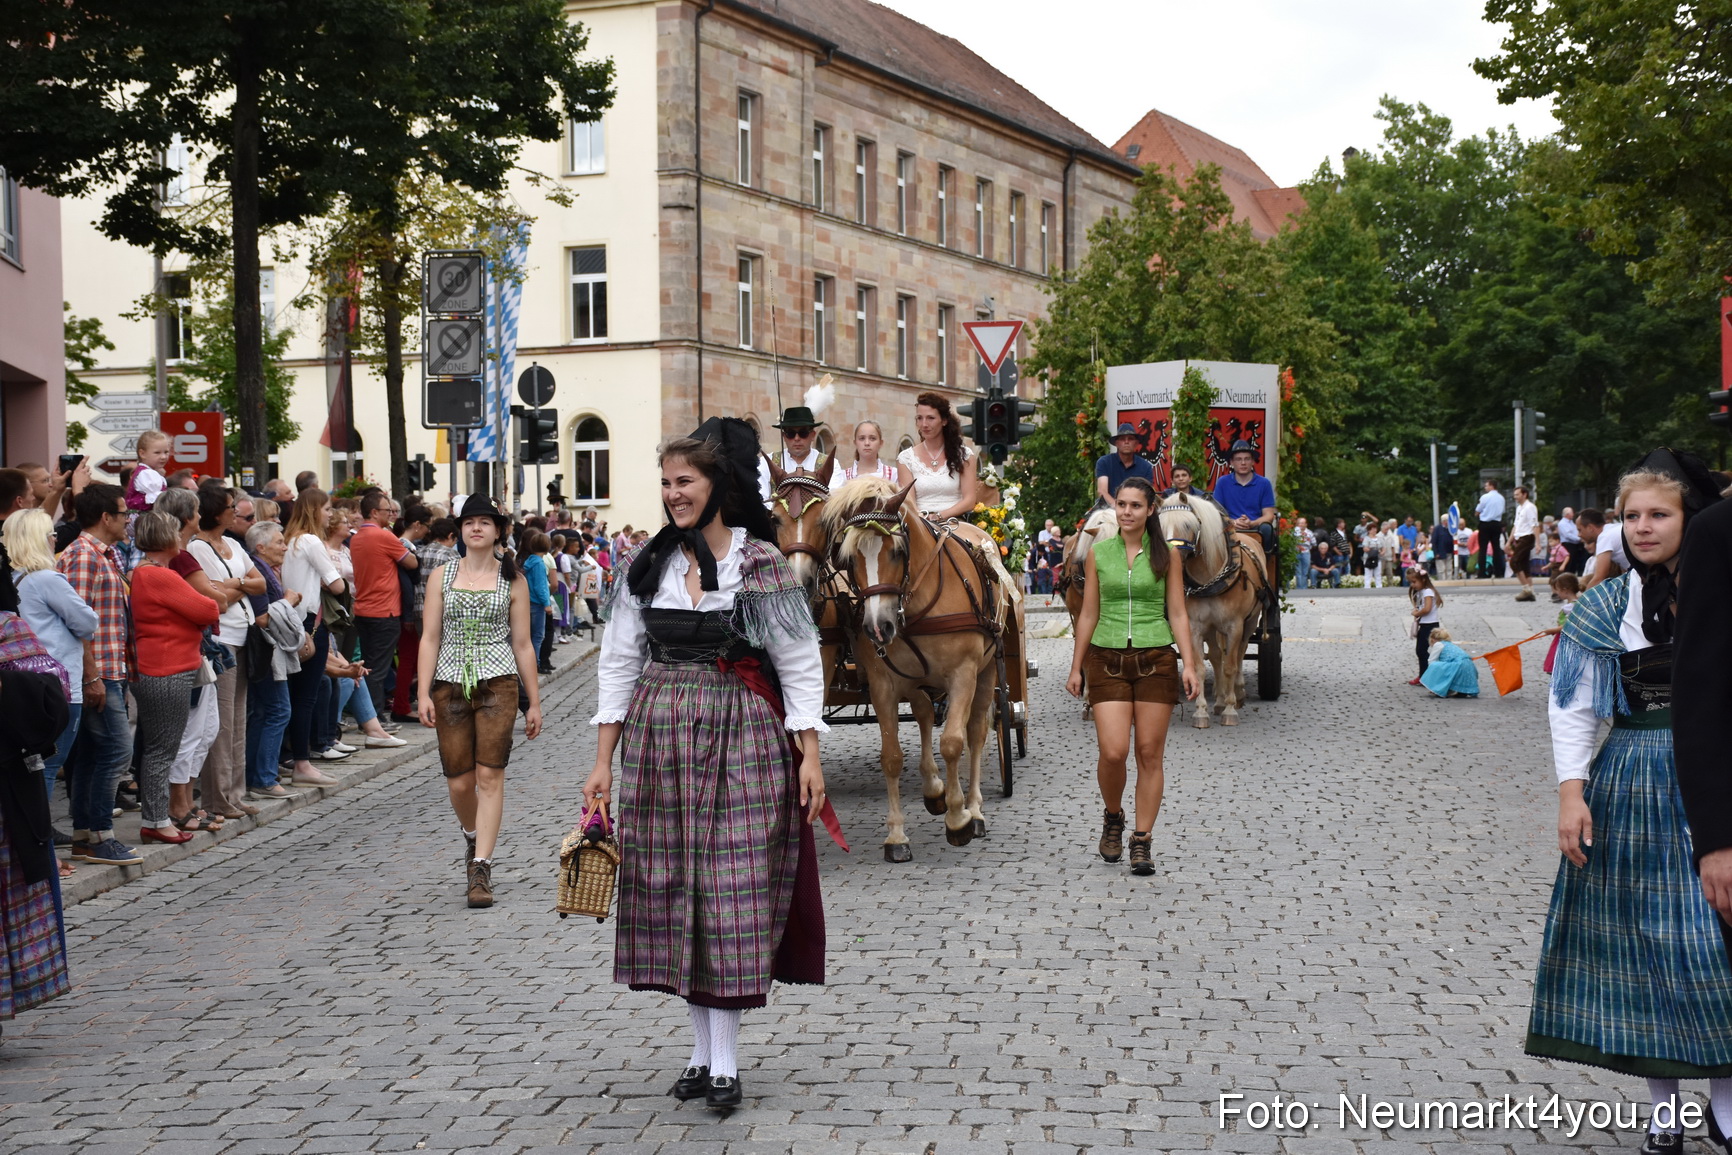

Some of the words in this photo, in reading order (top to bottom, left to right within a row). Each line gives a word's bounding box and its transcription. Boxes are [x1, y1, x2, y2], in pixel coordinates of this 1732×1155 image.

[444, 271, 465, 287] 30
[441, 300, 468, 309] ZONE
[441, 362, 468, 372] ZONE
[1116, 390, 1135, 406] Stadt
[1136, 388, 1173, 405] Neumarkt
[1225, 388, 1267, 404] Neumarkt
